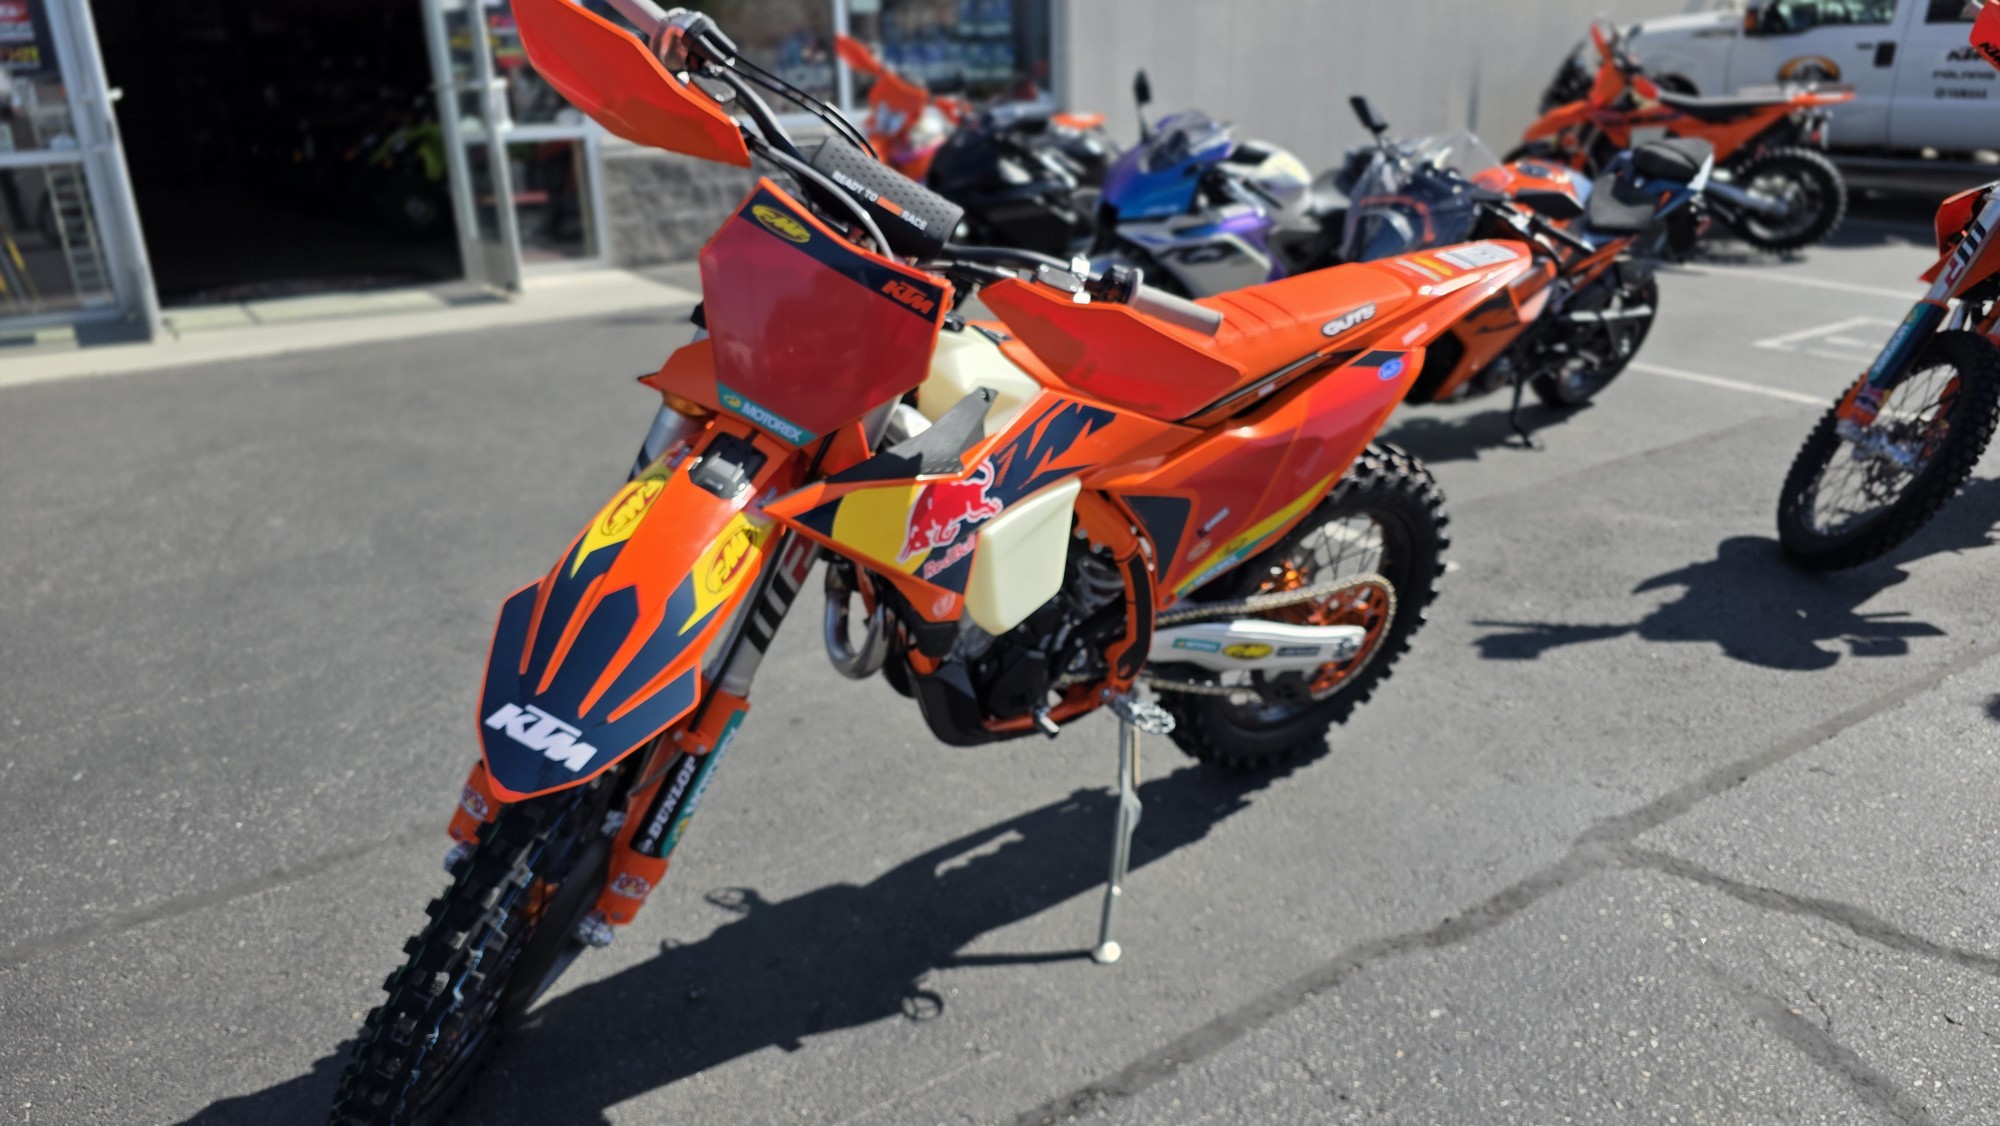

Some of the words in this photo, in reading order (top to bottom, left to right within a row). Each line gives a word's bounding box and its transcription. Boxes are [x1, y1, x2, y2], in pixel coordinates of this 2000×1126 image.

[832, 170, 866, 194] READY
[864, 188, 878, 202] TO
[901, 210, 928, 231] RACE
[881, 280, 934, 314] KTM
[1322, 303, 1376, 336] GUTS
[742, 402, 802, 442] MOTOREX
[485, 702, 598, 772] KTM
[648, 755, 696, 841] DUNLOP
